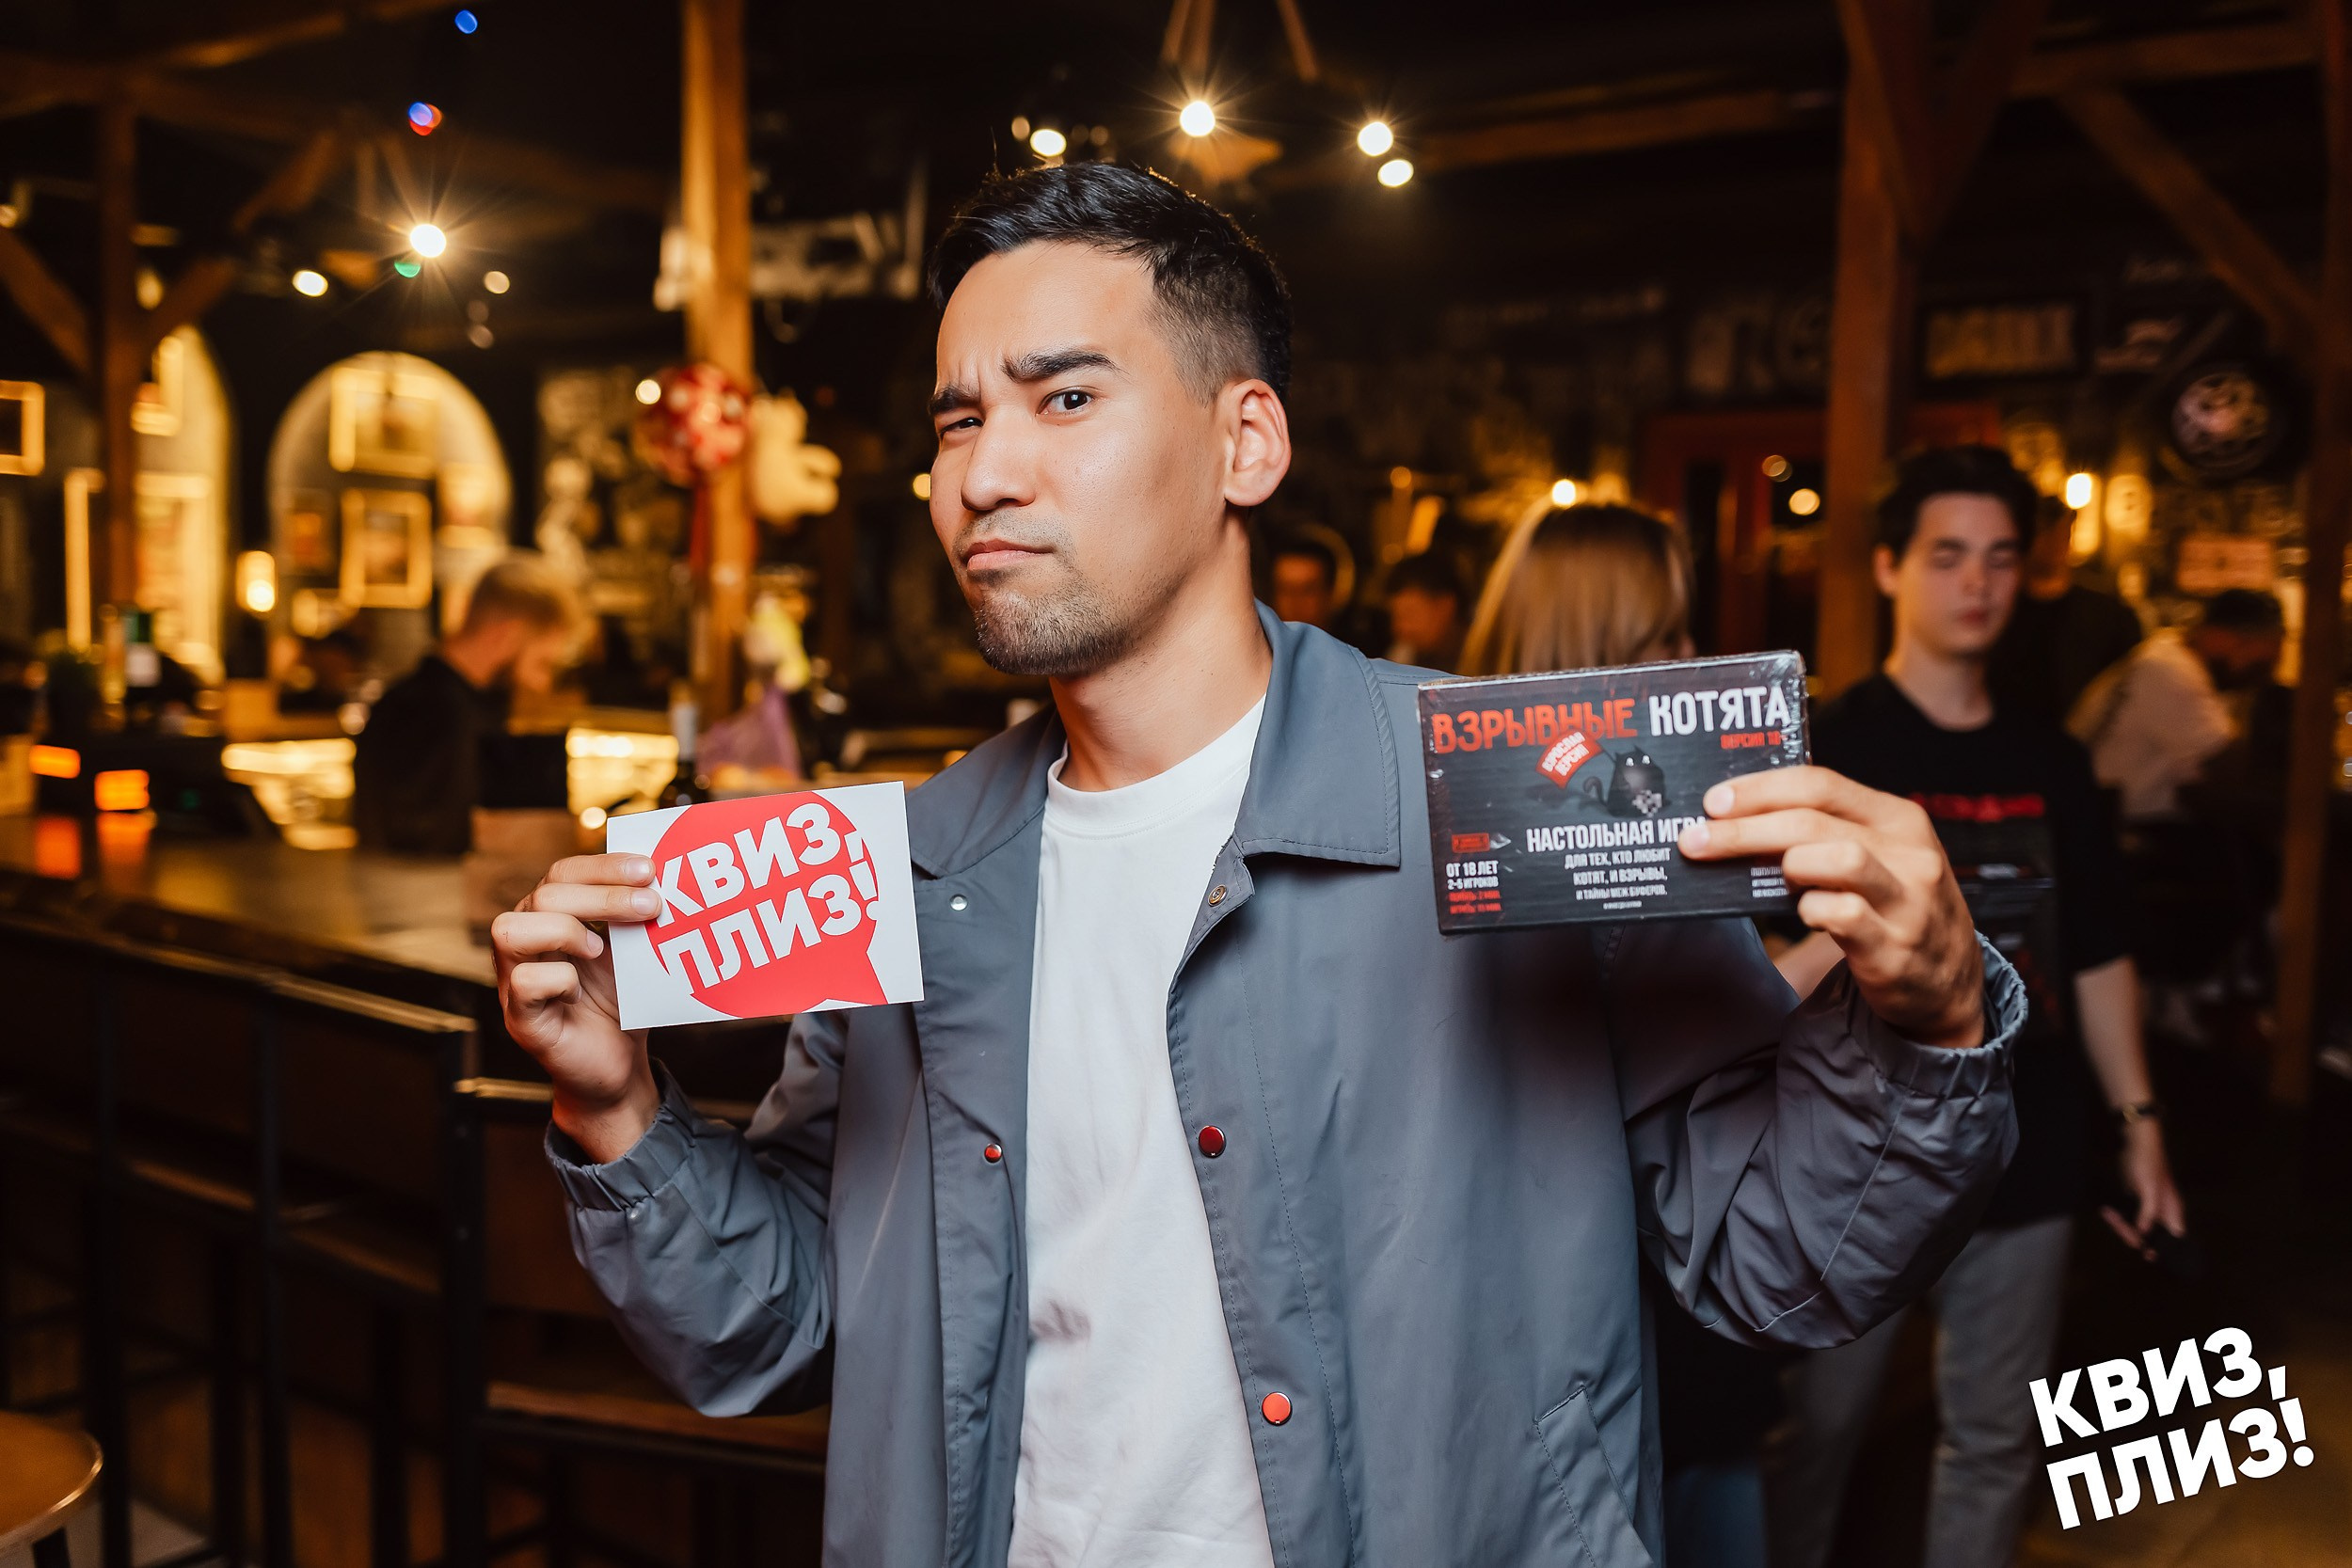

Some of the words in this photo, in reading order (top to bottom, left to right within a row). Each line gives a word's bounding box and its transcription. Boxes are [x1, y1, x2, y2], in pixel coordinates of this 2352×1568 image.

[1432, 697, 1638, 753] ВЗРЫВНЫЕ
[1648, 685, 1791, 736] КОТЯТА
[1526, 820, 1655, 852] НАСТОЛЬНАЯ
[1658, 816, 1708, 844] ИГ
[654, 802, 865, 928] КВИЗ,
[1446, 863, 1460, 878] ОТ
[1463, 862, 1476, 877] 18
[1477, 860, 1499, 876] ЛЕТ
[1565, 853, 1588, 869] ДЛЯ
[1588, 851, 1612, 866] ТЕХ,
[1612, 850, 1632, 864] КТО
[1633, 847, 1671, 863] ЛЮБИТ
[1463, 876, 1499, 889] ИГРОКОВ
[1609, 869, 1618, 883] И
[1618, 866, 1668, 883] ВЗРЫВЫ,
[658, 860, 879, 996] ПЛИЗ!
